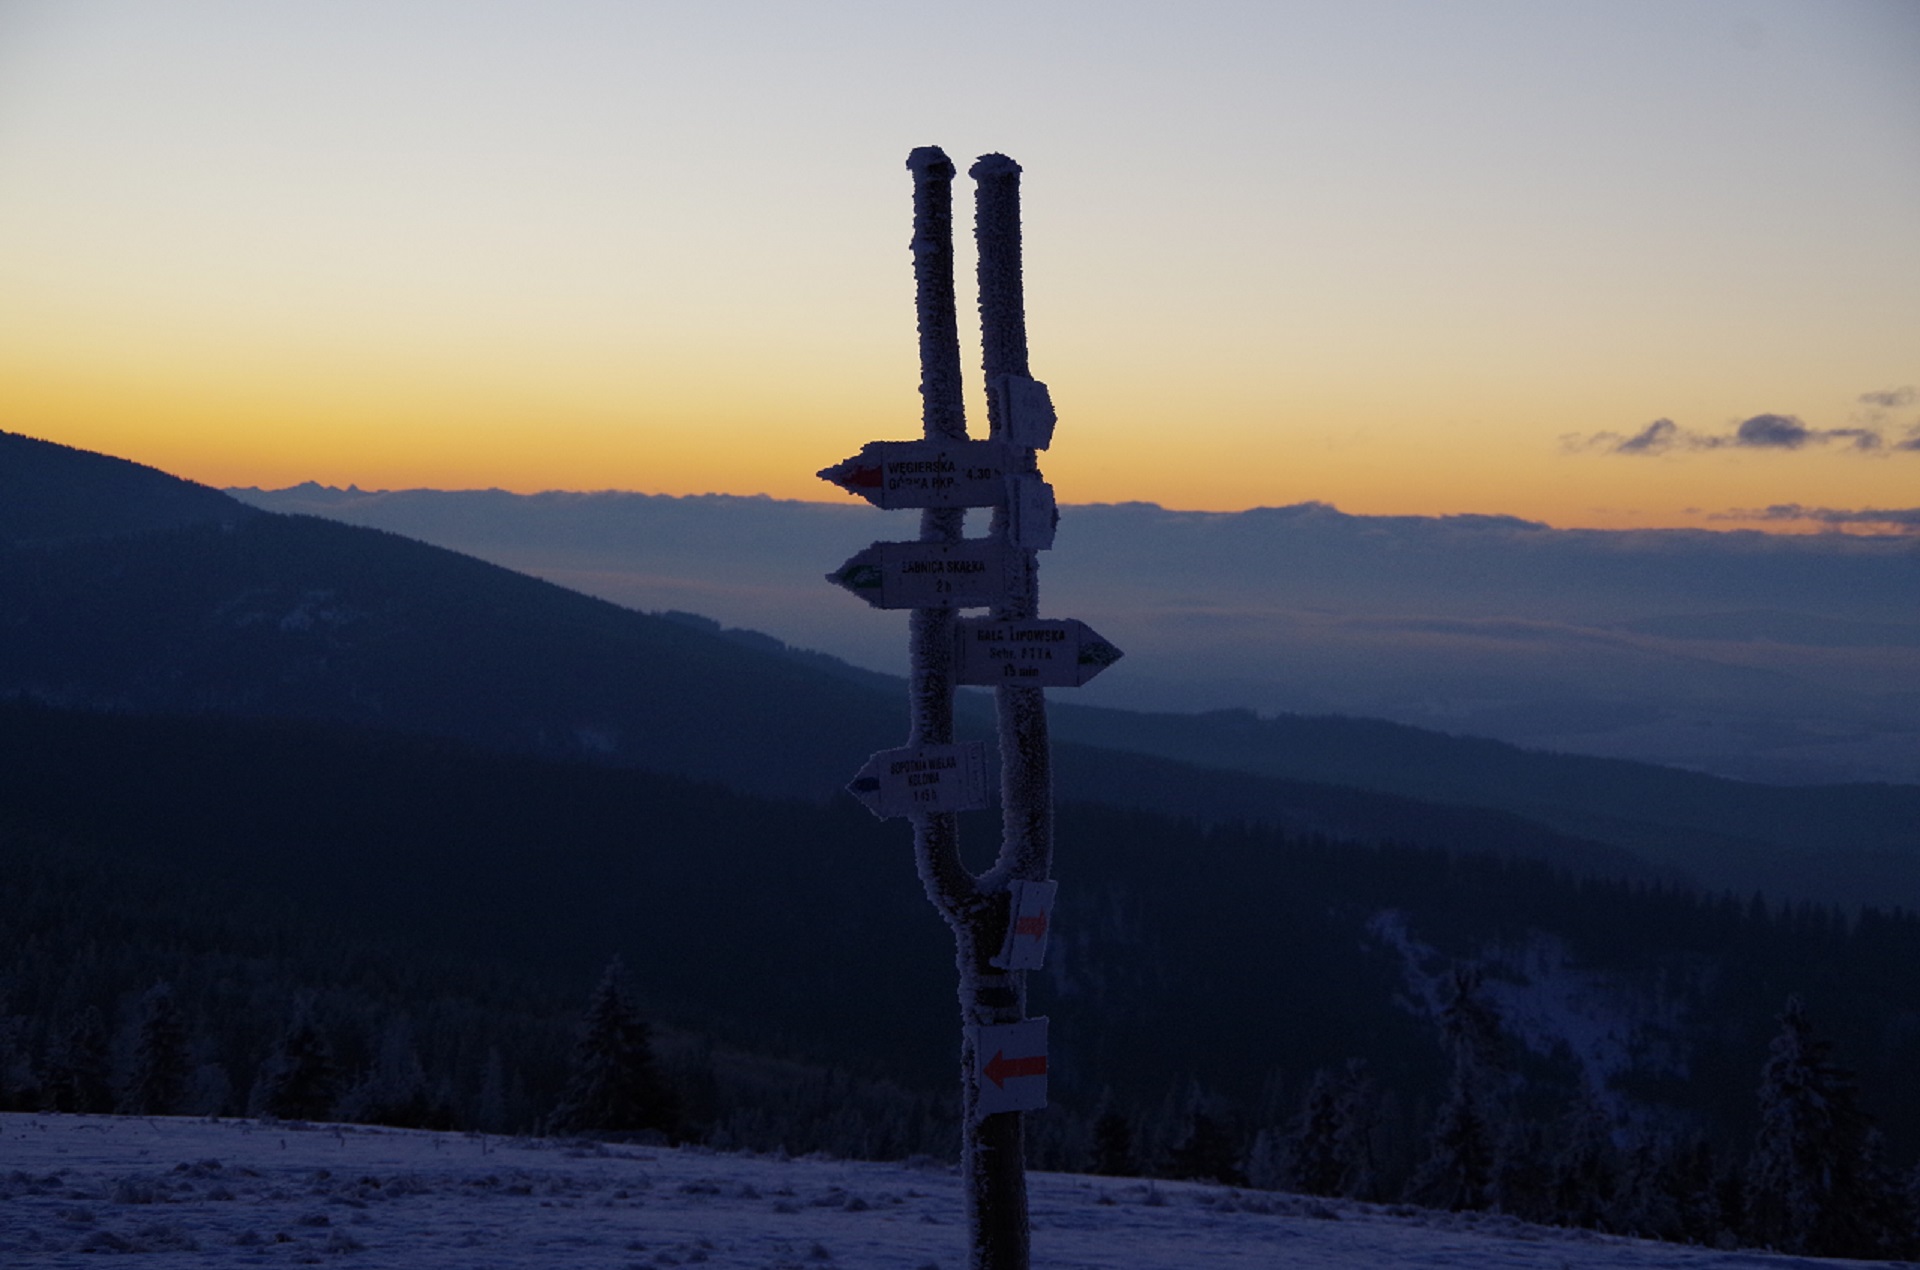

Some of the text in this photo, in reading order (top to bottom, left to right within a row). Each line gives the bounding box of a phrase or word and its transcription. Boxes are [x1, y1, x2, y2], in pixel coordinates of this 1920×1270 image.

[887, 461, 955, 475] WĘGIERSKA
[966, 468, 991, 480] 4.30
[929, 476, 954, 488] PKP
[936, 579, 943, 592] 2
